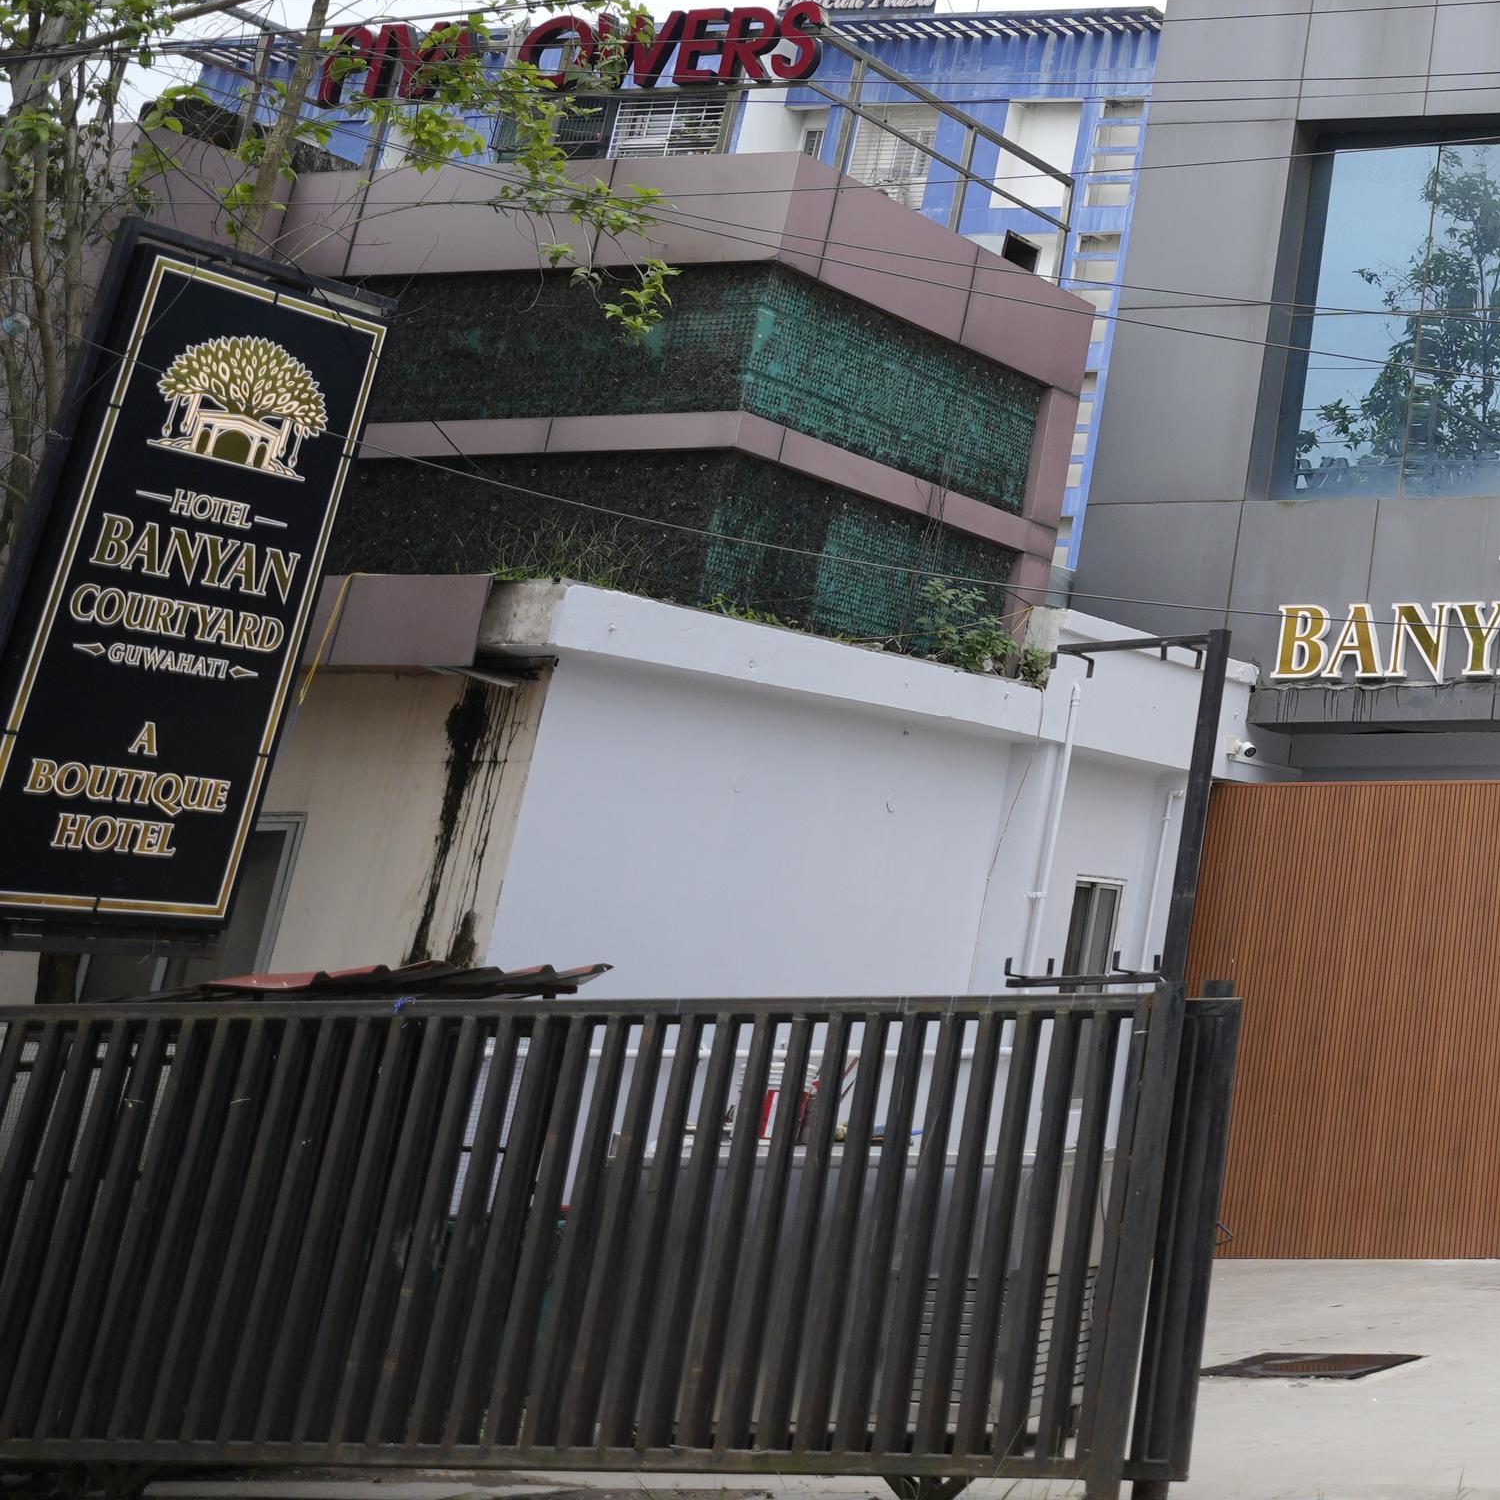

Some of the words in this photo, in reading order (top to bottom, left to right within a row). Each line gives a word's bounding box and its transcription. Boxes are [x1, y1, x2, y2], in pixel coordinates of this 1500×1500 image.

[170, 487, 252, 529] HOTEL
[89, 513, 302, 607] BANYAN
[69, 582, 286, 655] COURTYARD
[107, 641, 230, 682] GUWAHATI
[128, 720, 159, 756] A
[23, 757, 232, 817] BOUTIQUE
[50, 813, 178, 859] HOTEL
